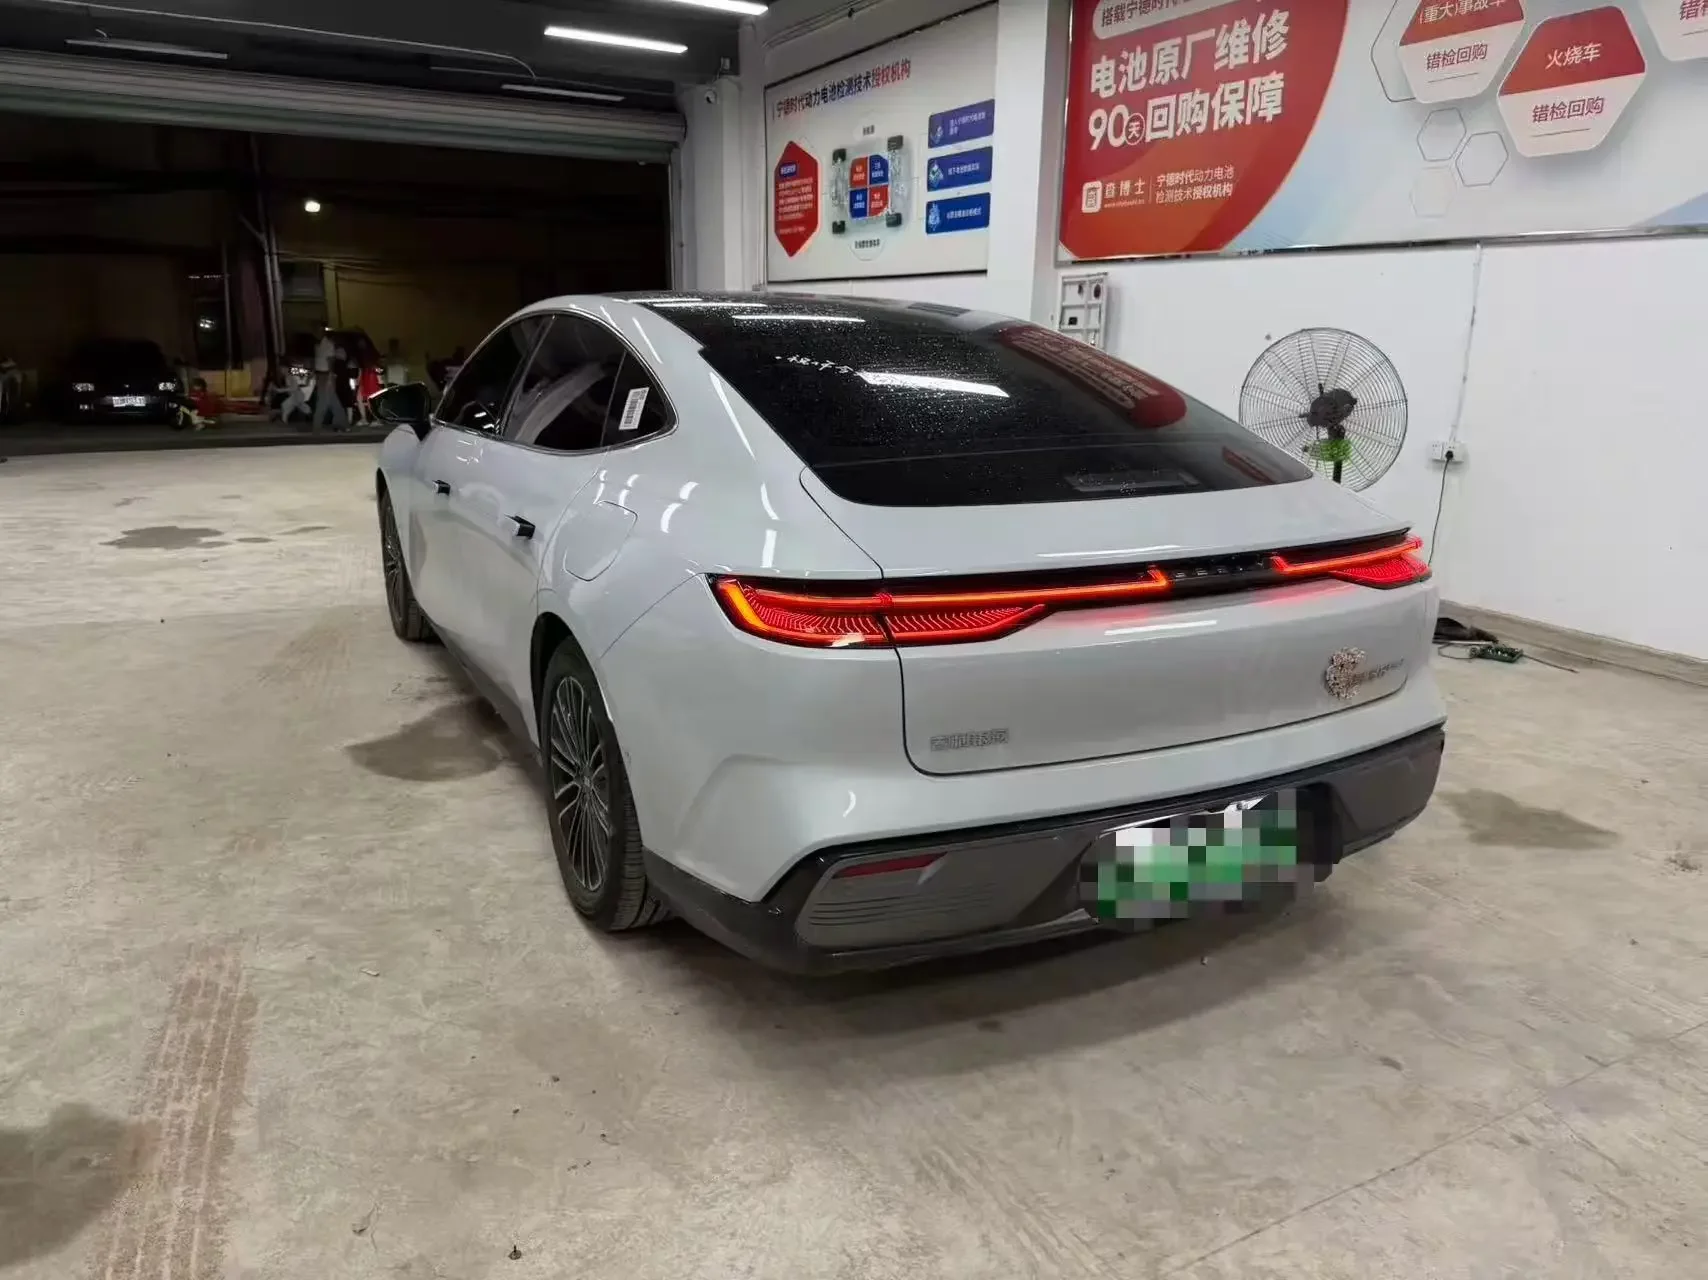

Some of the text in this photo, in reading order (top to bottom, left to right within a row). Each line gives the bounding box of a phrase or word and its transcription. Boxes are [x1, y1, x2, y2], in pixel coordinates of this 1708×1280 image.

[1091, 9, 1290, 98] 电池原厂维修
[1426, 43, 1489, 70] 错检回购
[1545, 42, 1602, 70] 火烧车
[1532, 97, 1606, 123] 错检回购
[1156, 164, 1235, 188] 宁德时代动力电池
[1155, 182, 1234, 204] 检测技术授权机构
